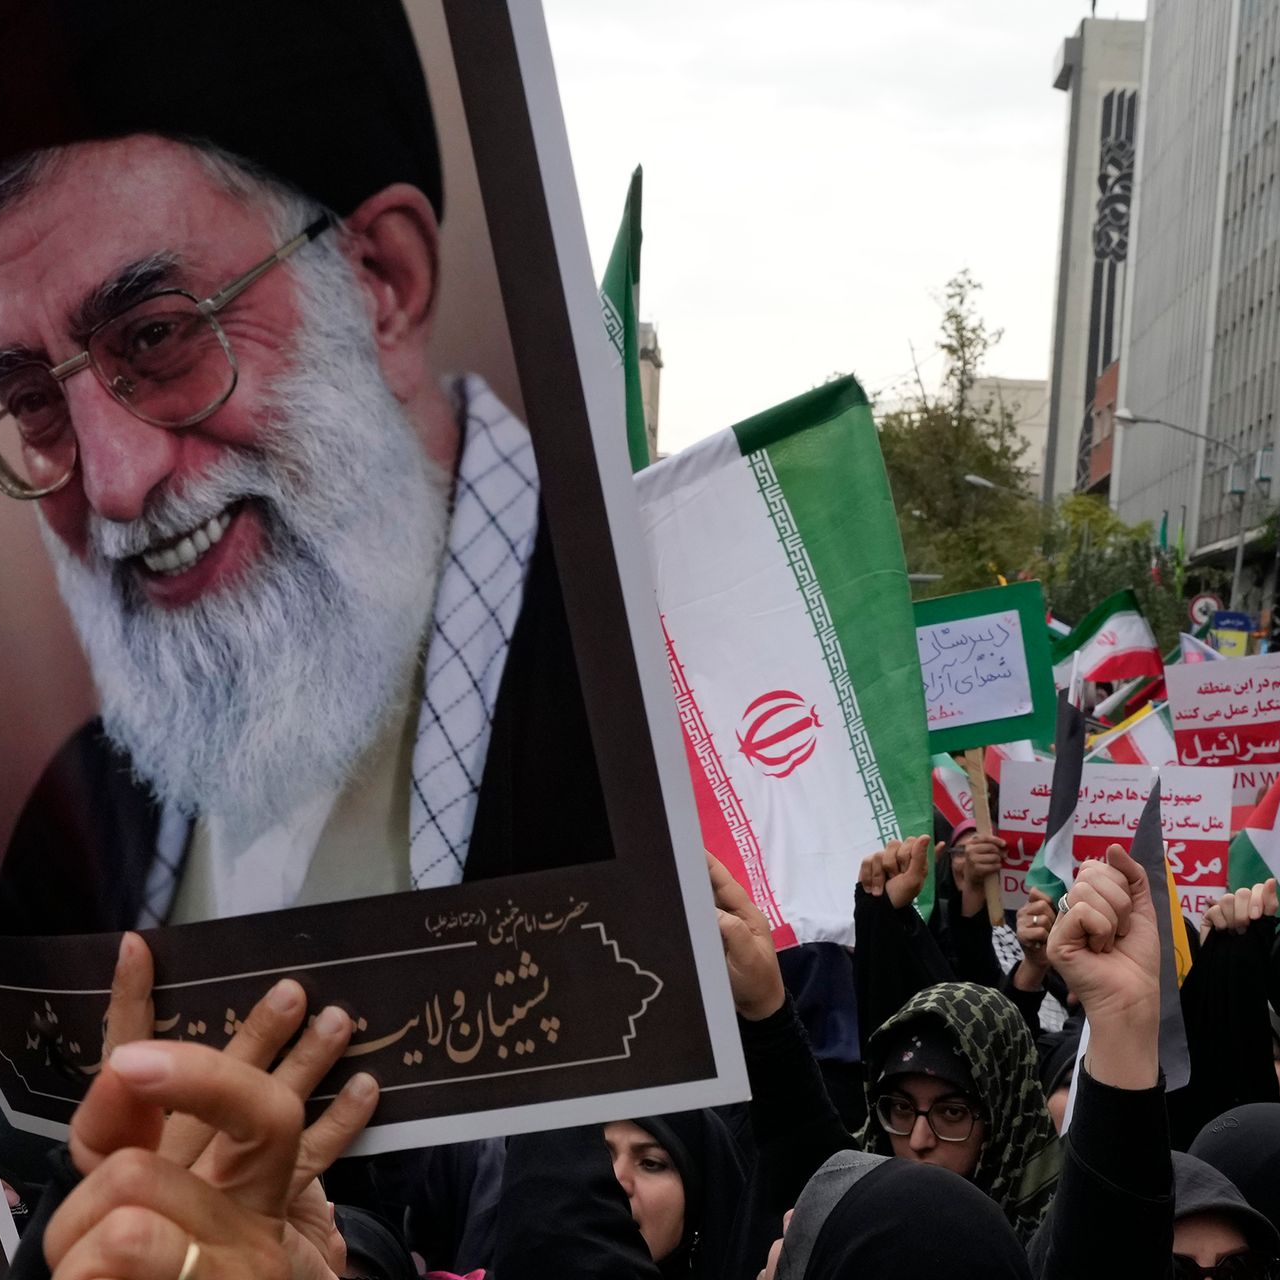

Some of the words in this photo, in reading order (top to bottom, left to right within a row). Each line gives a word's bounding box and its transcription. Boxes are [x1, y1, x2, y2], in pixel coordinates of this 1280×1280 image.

[1090, 792, 1104, 804] در
[1107, 791, 1124, 803] هم
[1125, 788, 1138, 800] ها
[1202, 816, 1224, 832] مثل
